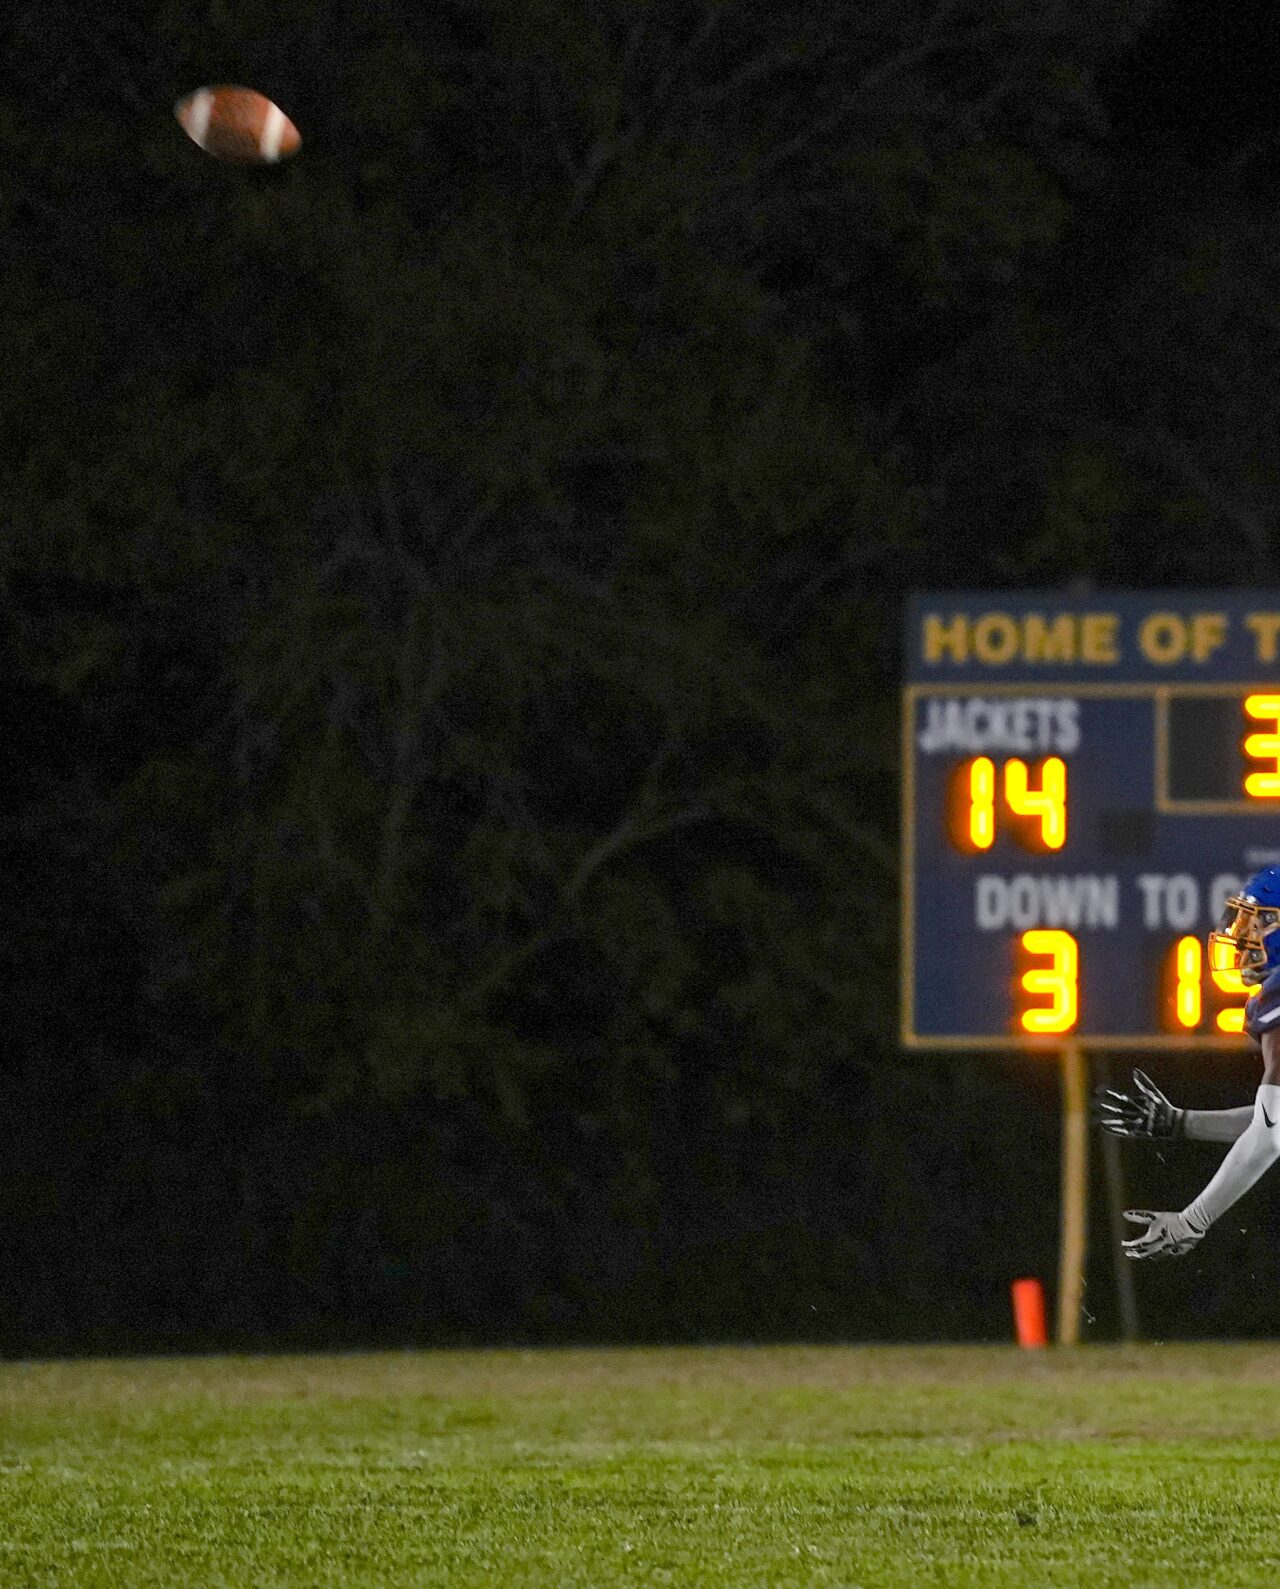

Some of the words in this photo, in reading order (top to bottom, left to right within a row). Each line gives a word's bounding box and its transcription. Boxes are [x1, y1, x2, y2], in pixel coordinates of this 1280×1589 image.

[922, 613, 1120, 665] HOME
[1138, 612, 1228, 664] OF
[918, 699, 1081, 753] JACKETS
[969, 756, 1067, 850] 14
[975, 874, 1119, 930] DOWN
[1138, 873, 1199, 930] TO
[1021, 930, 1078, 1033] 3
